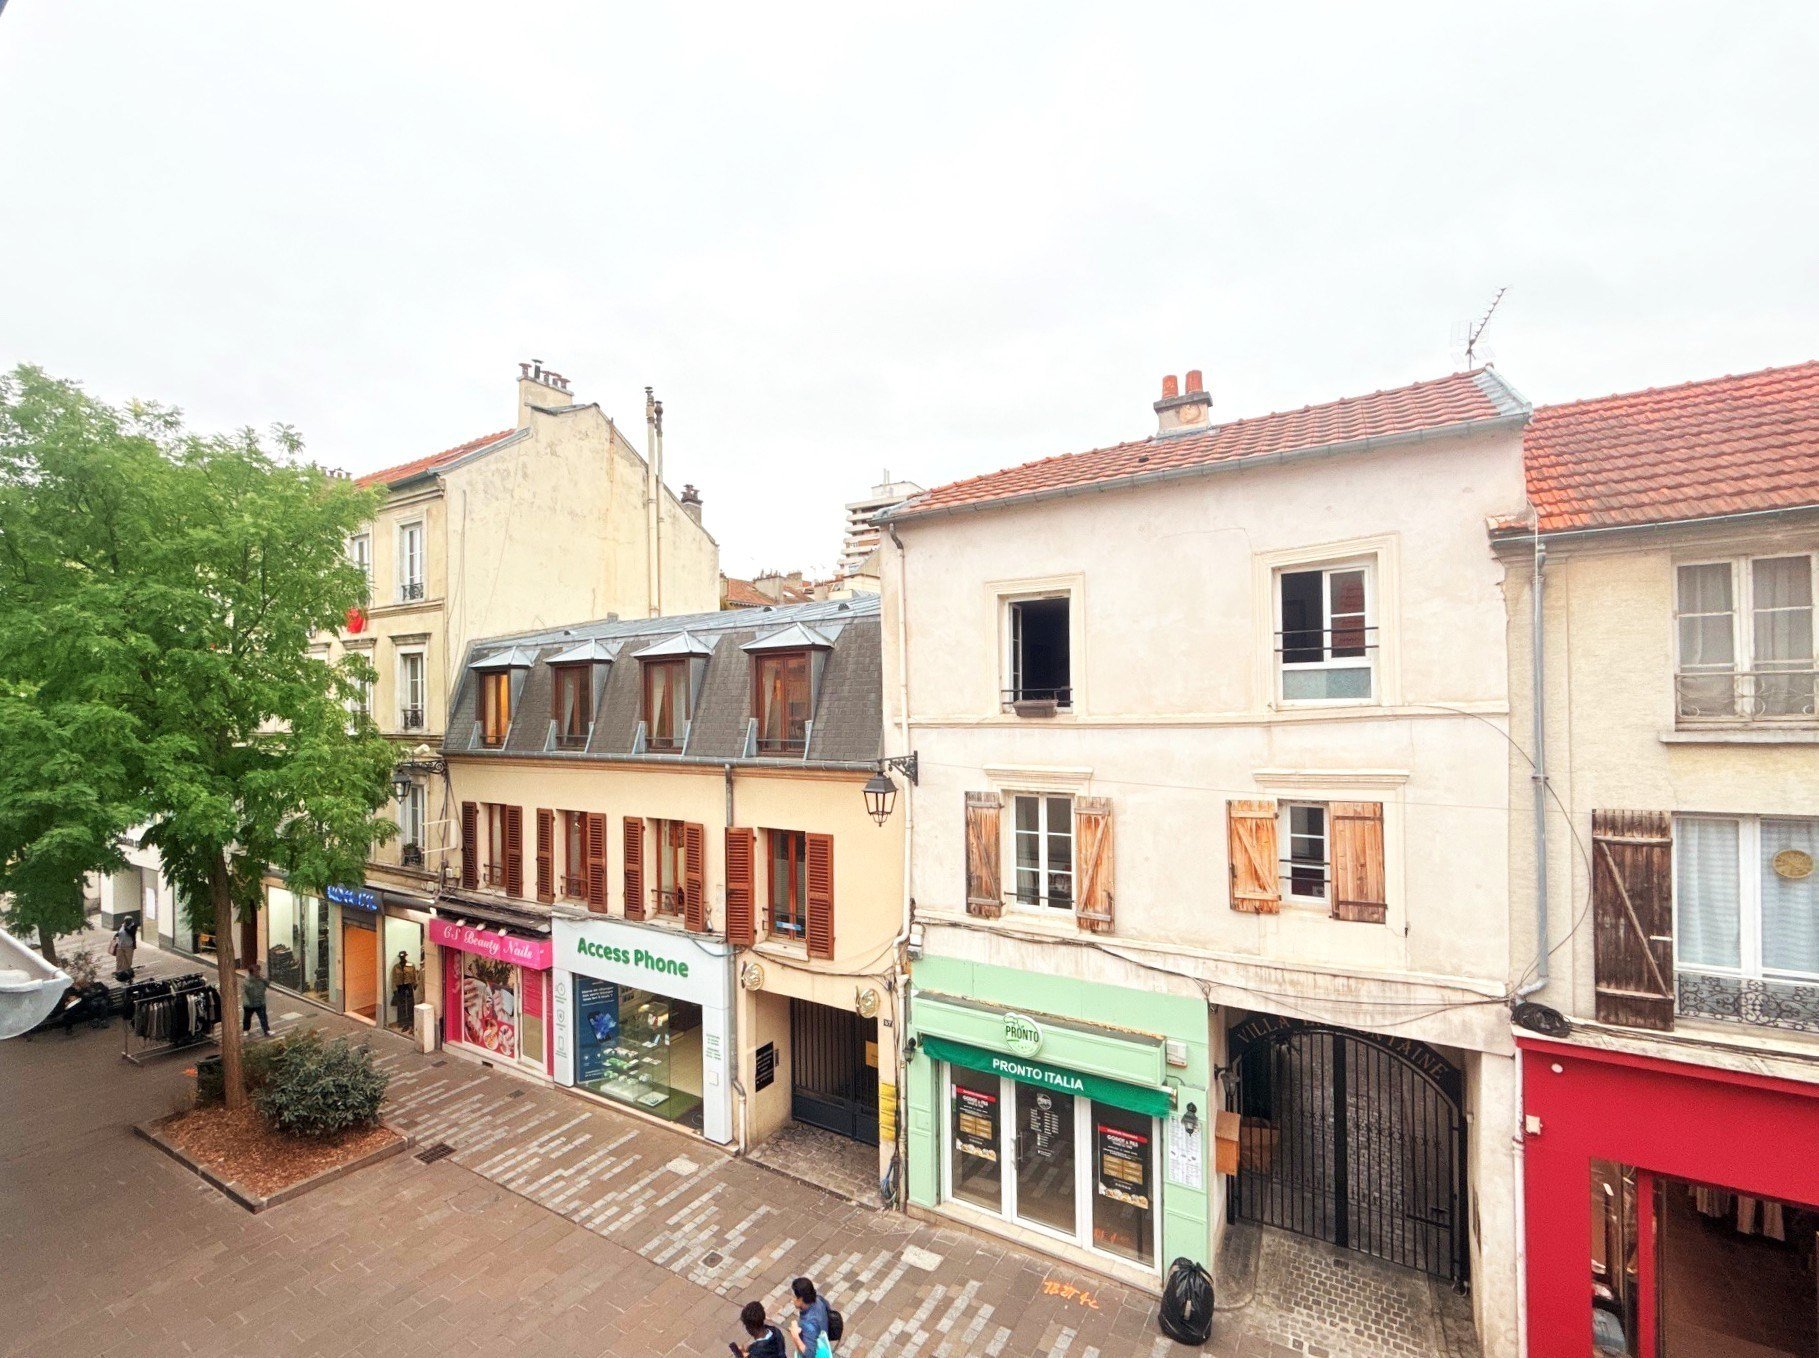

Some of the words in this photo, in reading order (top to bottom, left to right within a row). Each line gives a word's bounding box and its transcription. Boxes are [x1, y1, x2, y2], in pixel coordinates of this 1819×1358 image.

[464, 930, 500, 955] Beauty
[503, 941, 533, 959] Nails
[577, 937, 630, 965] Access
[633, 949, 689, 978] Phone
[1005, 1025, 1040, 1043] PRONTO
[1237, 1016, 1290, 1044] VILLA
[992, 1058, 1042, 1080] PRONTO
[1044, 1071, 1084, 1091] ITALIA
